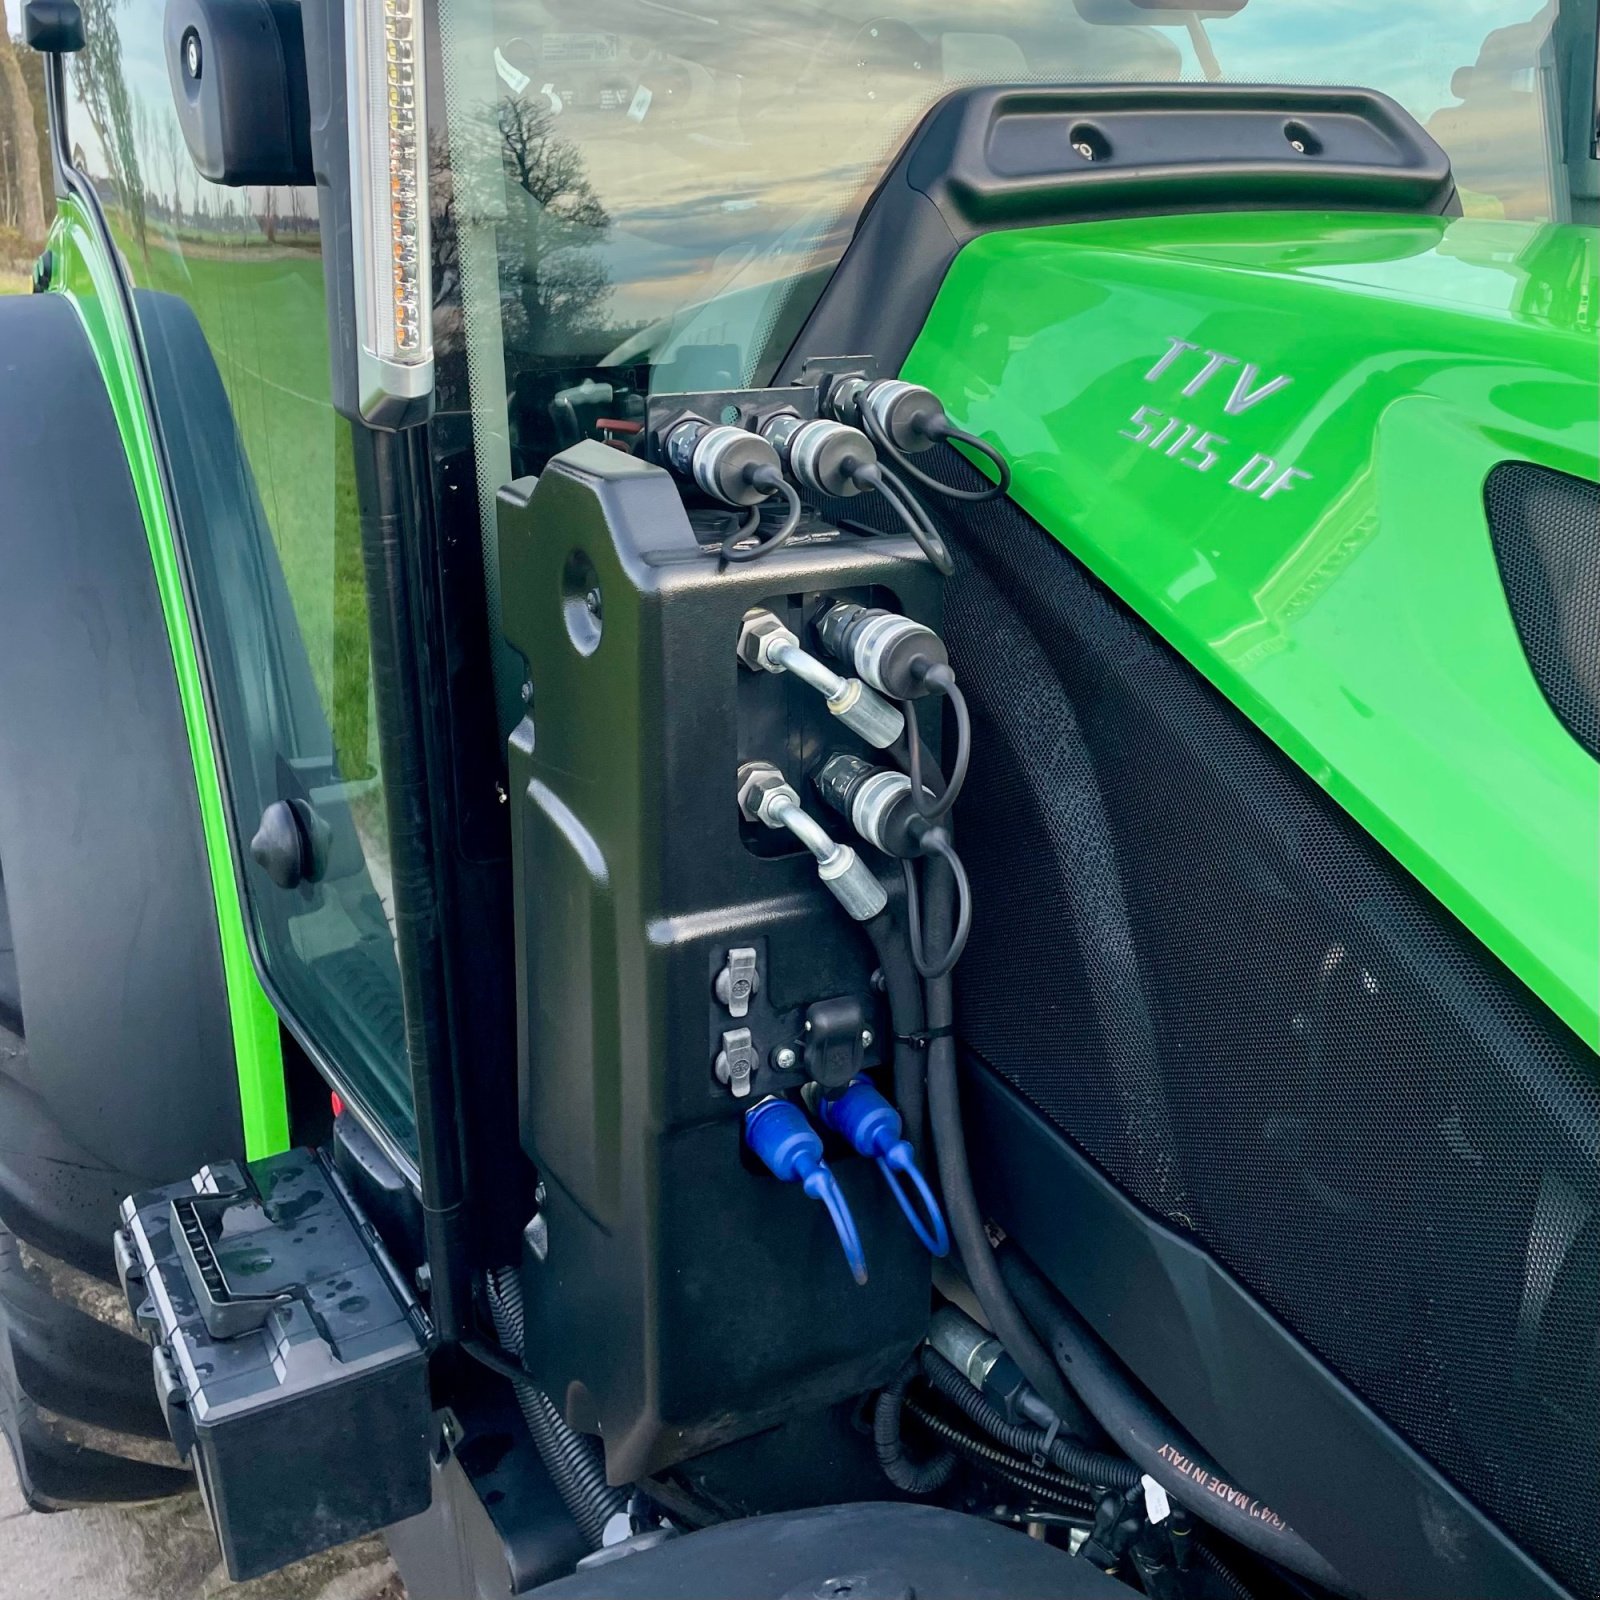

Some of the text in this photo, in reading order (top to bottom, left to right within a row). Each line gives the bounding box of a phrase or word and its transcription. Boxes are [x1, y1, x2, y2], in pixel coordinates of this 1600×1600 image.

[1144, 336, 1293, 416] TTV
[1118, 405, 1314, 501] 5115 DF
[1157, 1443, 1194, 1474] ITALY
[1192, 1466, 1209, 1486] IN
[1207, 1477, 1249, 1511] MADE
